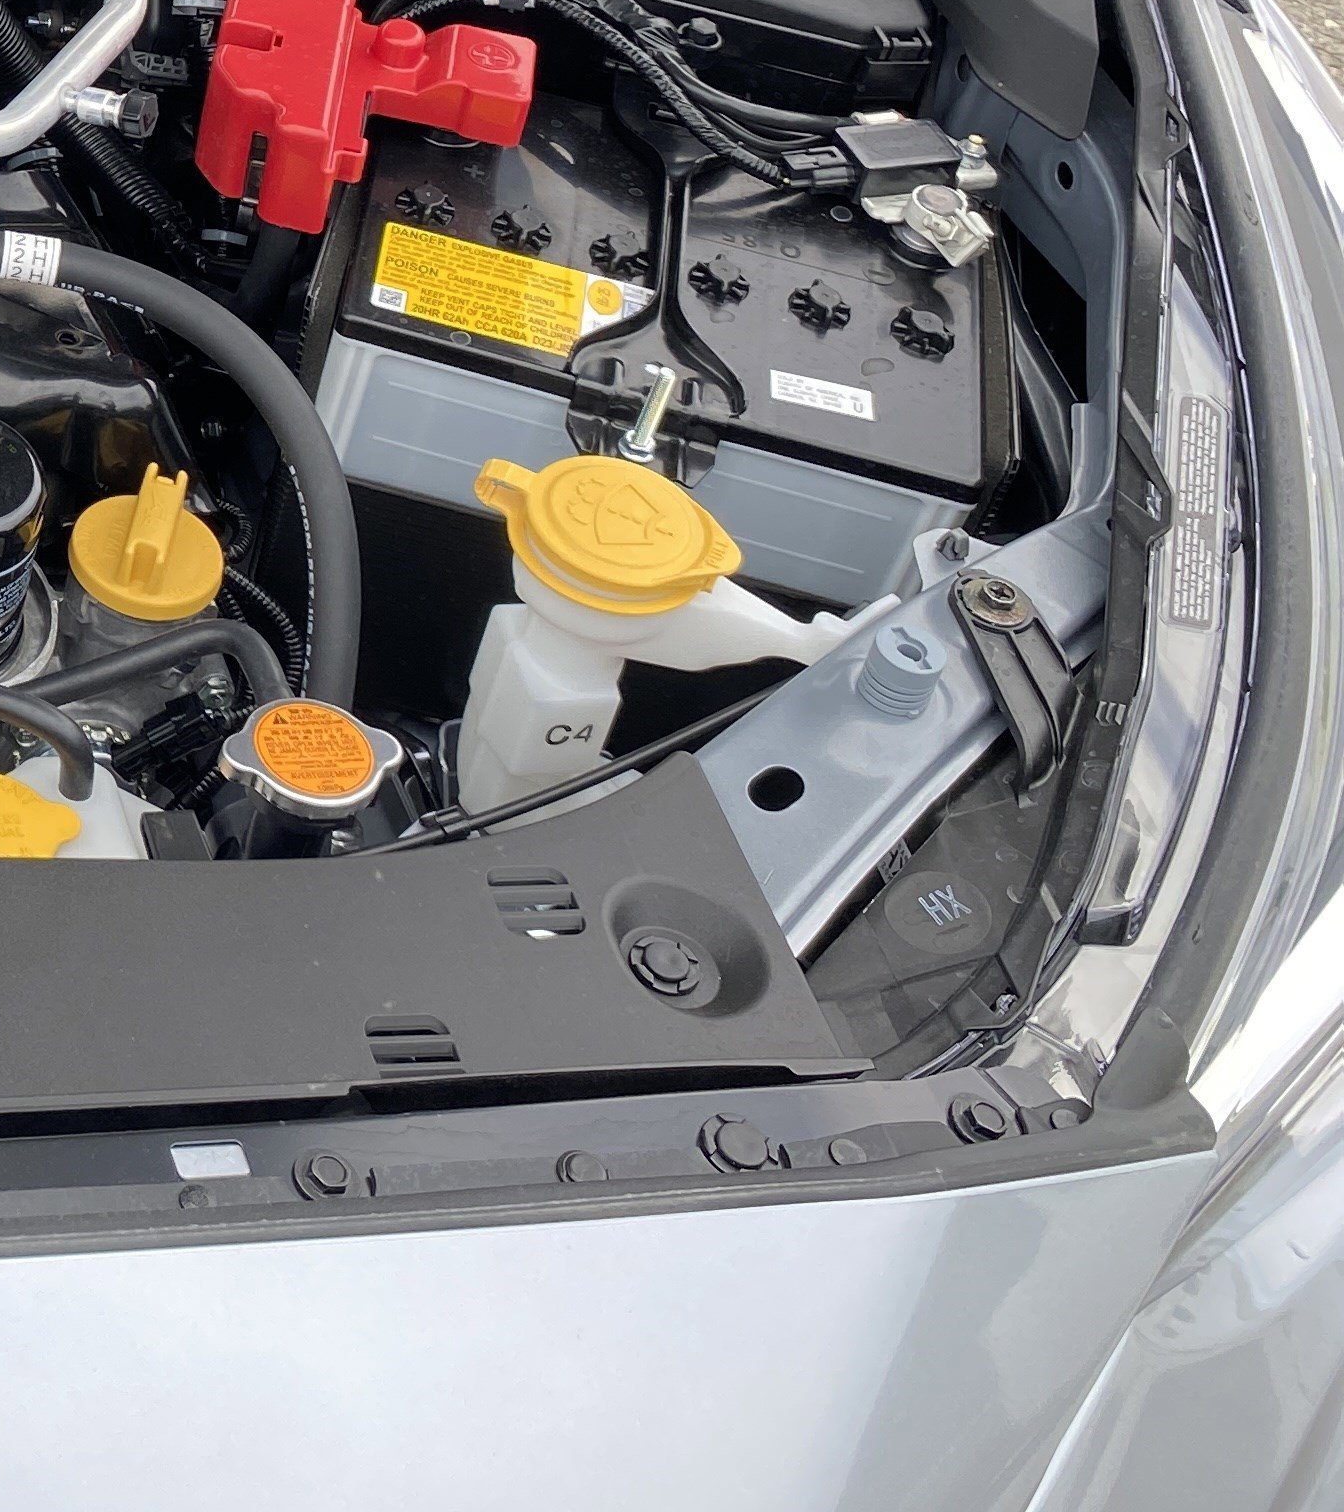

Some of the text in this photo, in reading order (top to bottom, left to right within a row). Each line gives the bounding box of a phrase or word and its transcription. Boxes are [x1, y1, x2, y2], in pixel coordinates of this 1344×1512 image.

[13, 248, 47, 267] 2 H
[390, 225, 447, 248] DANGER
[451, 242, 501, 261] EXPLOSIVE
[385, 256, 555, 307] POISON CAUSES SEVERE BURNS
[412, 303, 440, 319] 20HR
[475, 320, 500, 335] CCA
[419, 295, 443, 307] KEEP
[446, 303, 464, 314] OUT
[466, 308, 478, 317] OF
[481, 312, 512, 326] REACH
[514, 319, 527, 329] OF
[420, 287, 444, 299] KEEP
[447, 294, 471, 306] VENT
[472, 301, 497, 313] CAPS
[528, 315, 548, 327] AND
[853, 402, 864, 413] U
[545, 723, 594, 746] C4
[918, 884, 972, 926] HX
